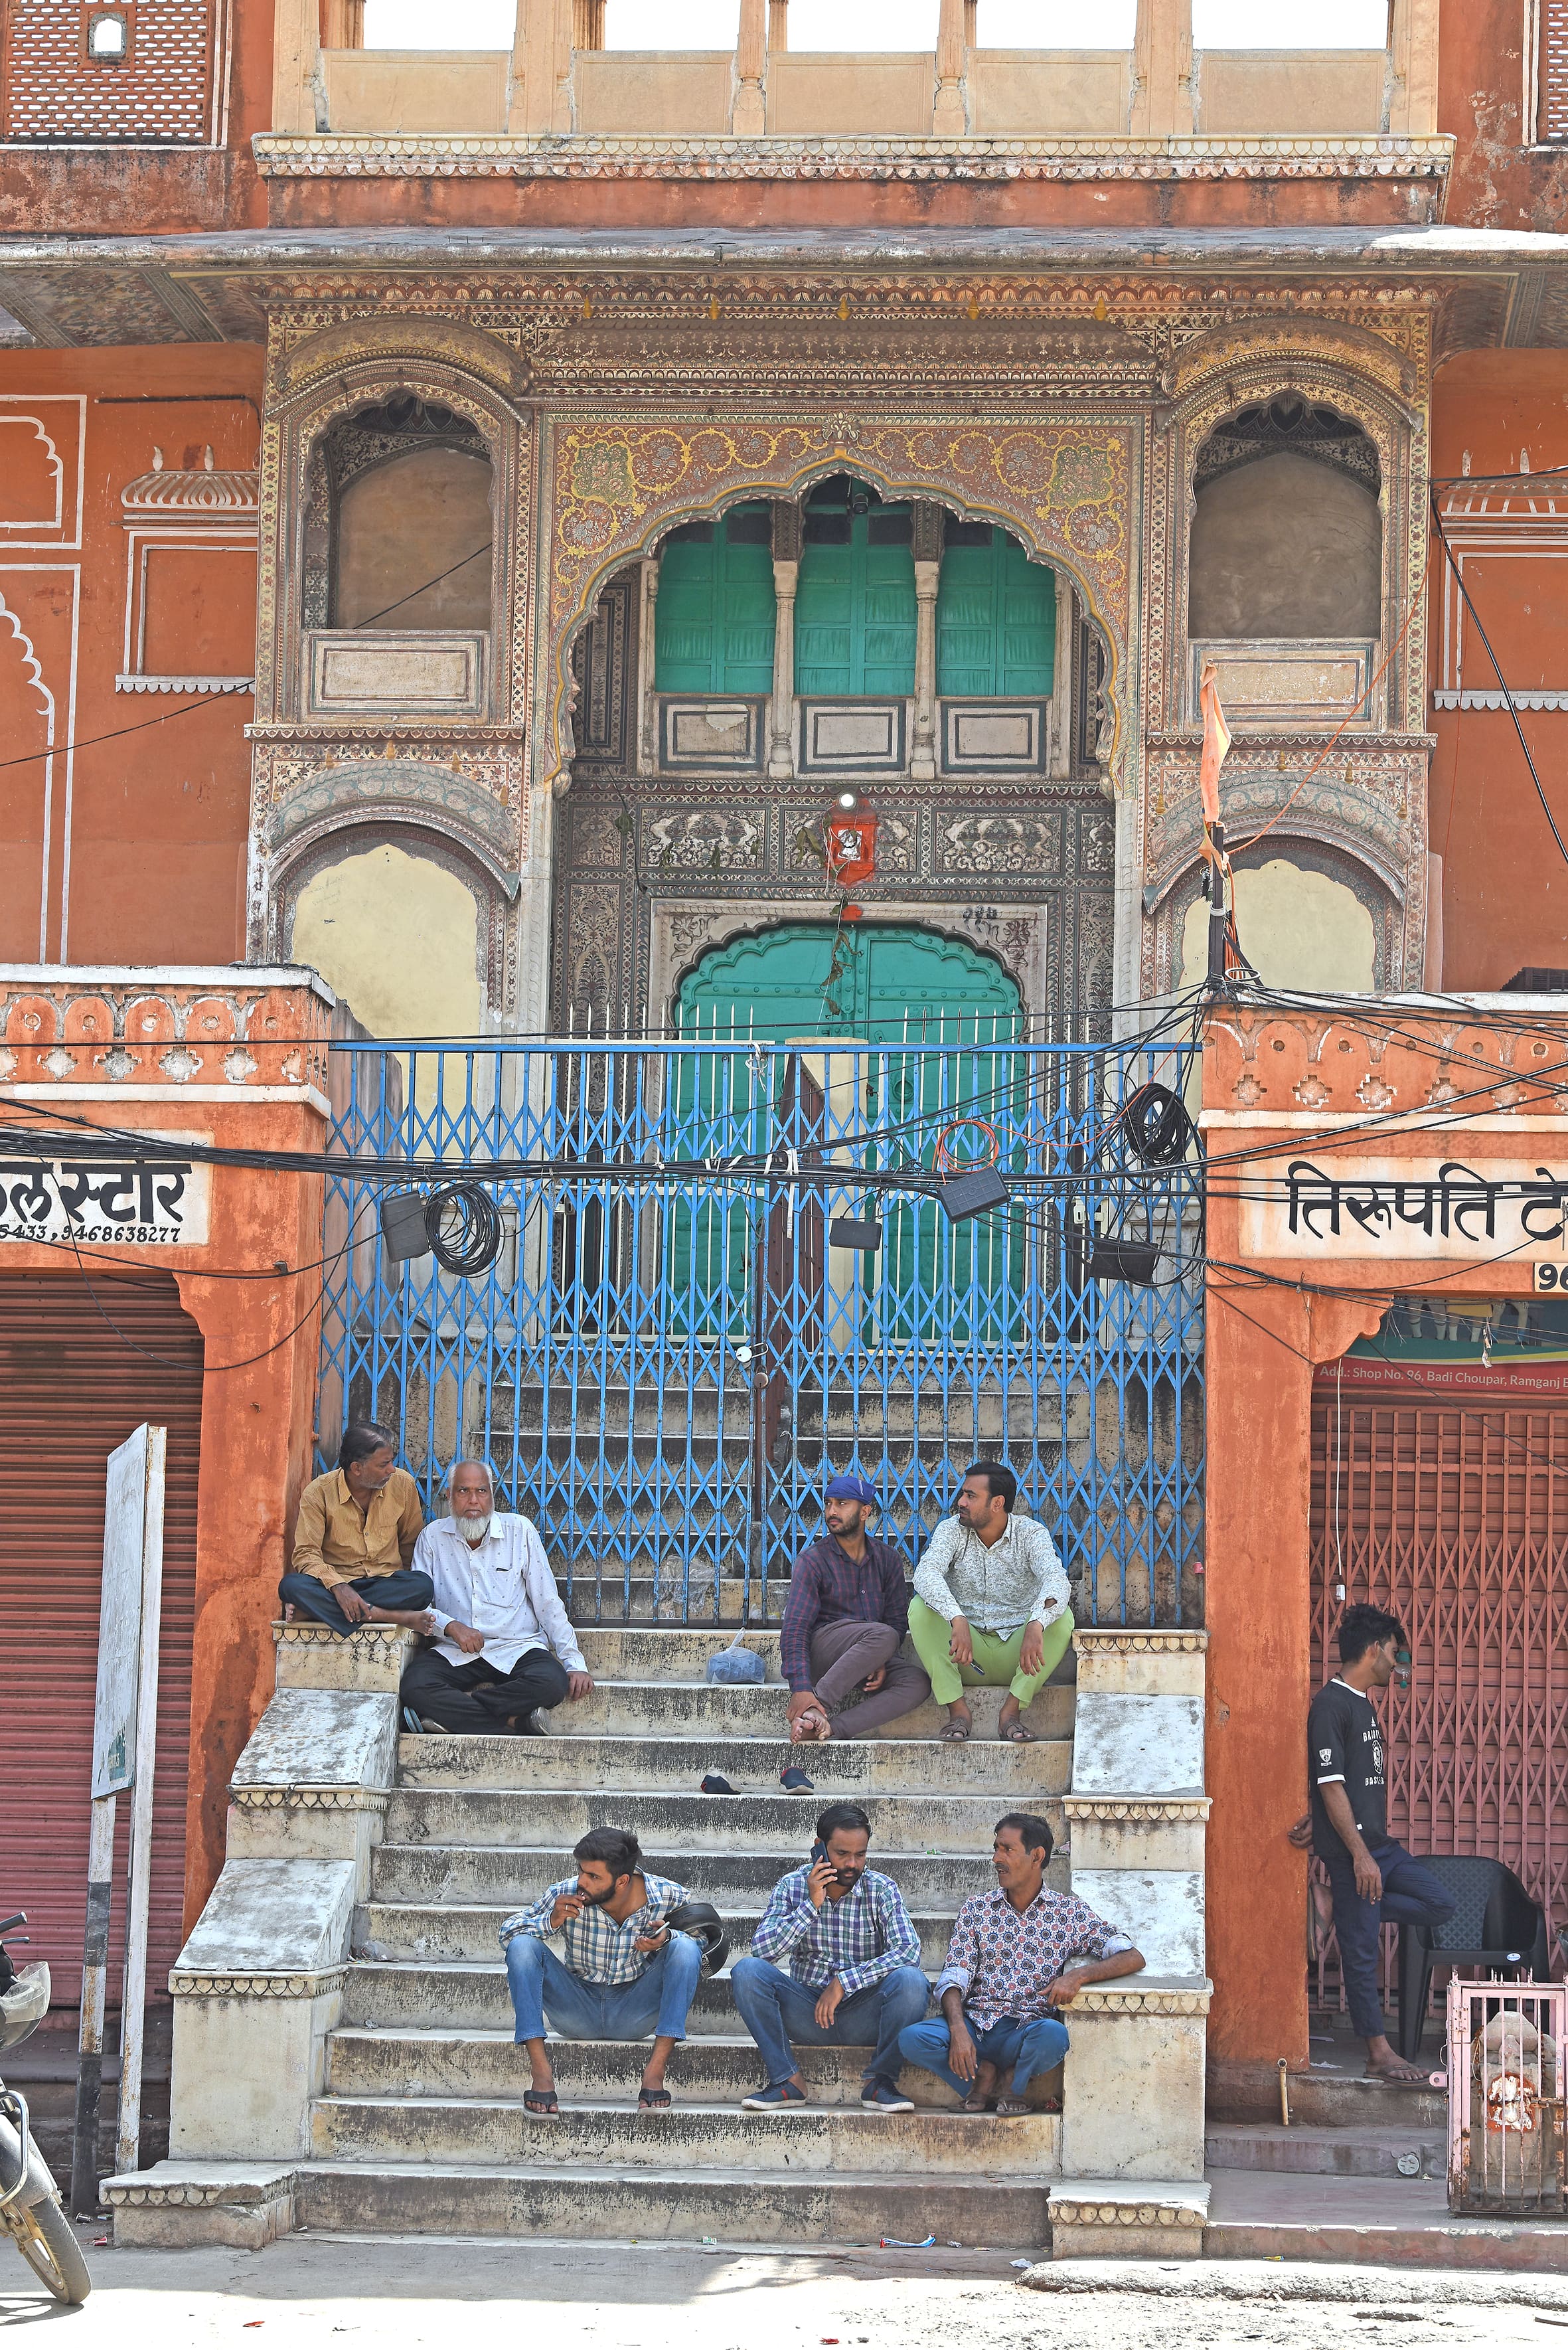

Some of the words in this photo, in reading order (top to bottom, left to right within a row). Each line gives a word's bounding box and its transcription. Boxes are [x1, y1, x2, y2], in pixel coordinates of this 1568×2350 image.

[1353, 1368, 1381, 1380] Shop
[1384, 1369, 1404, 1380] No.
[1407, 1370, 1424, 1382] 96,
[1427, 1371, 1452, 1383] Badi
[1455, 1373, 1508, 1386] Choupar,
[1510, 1375, 1560, 1389] Ramganj
